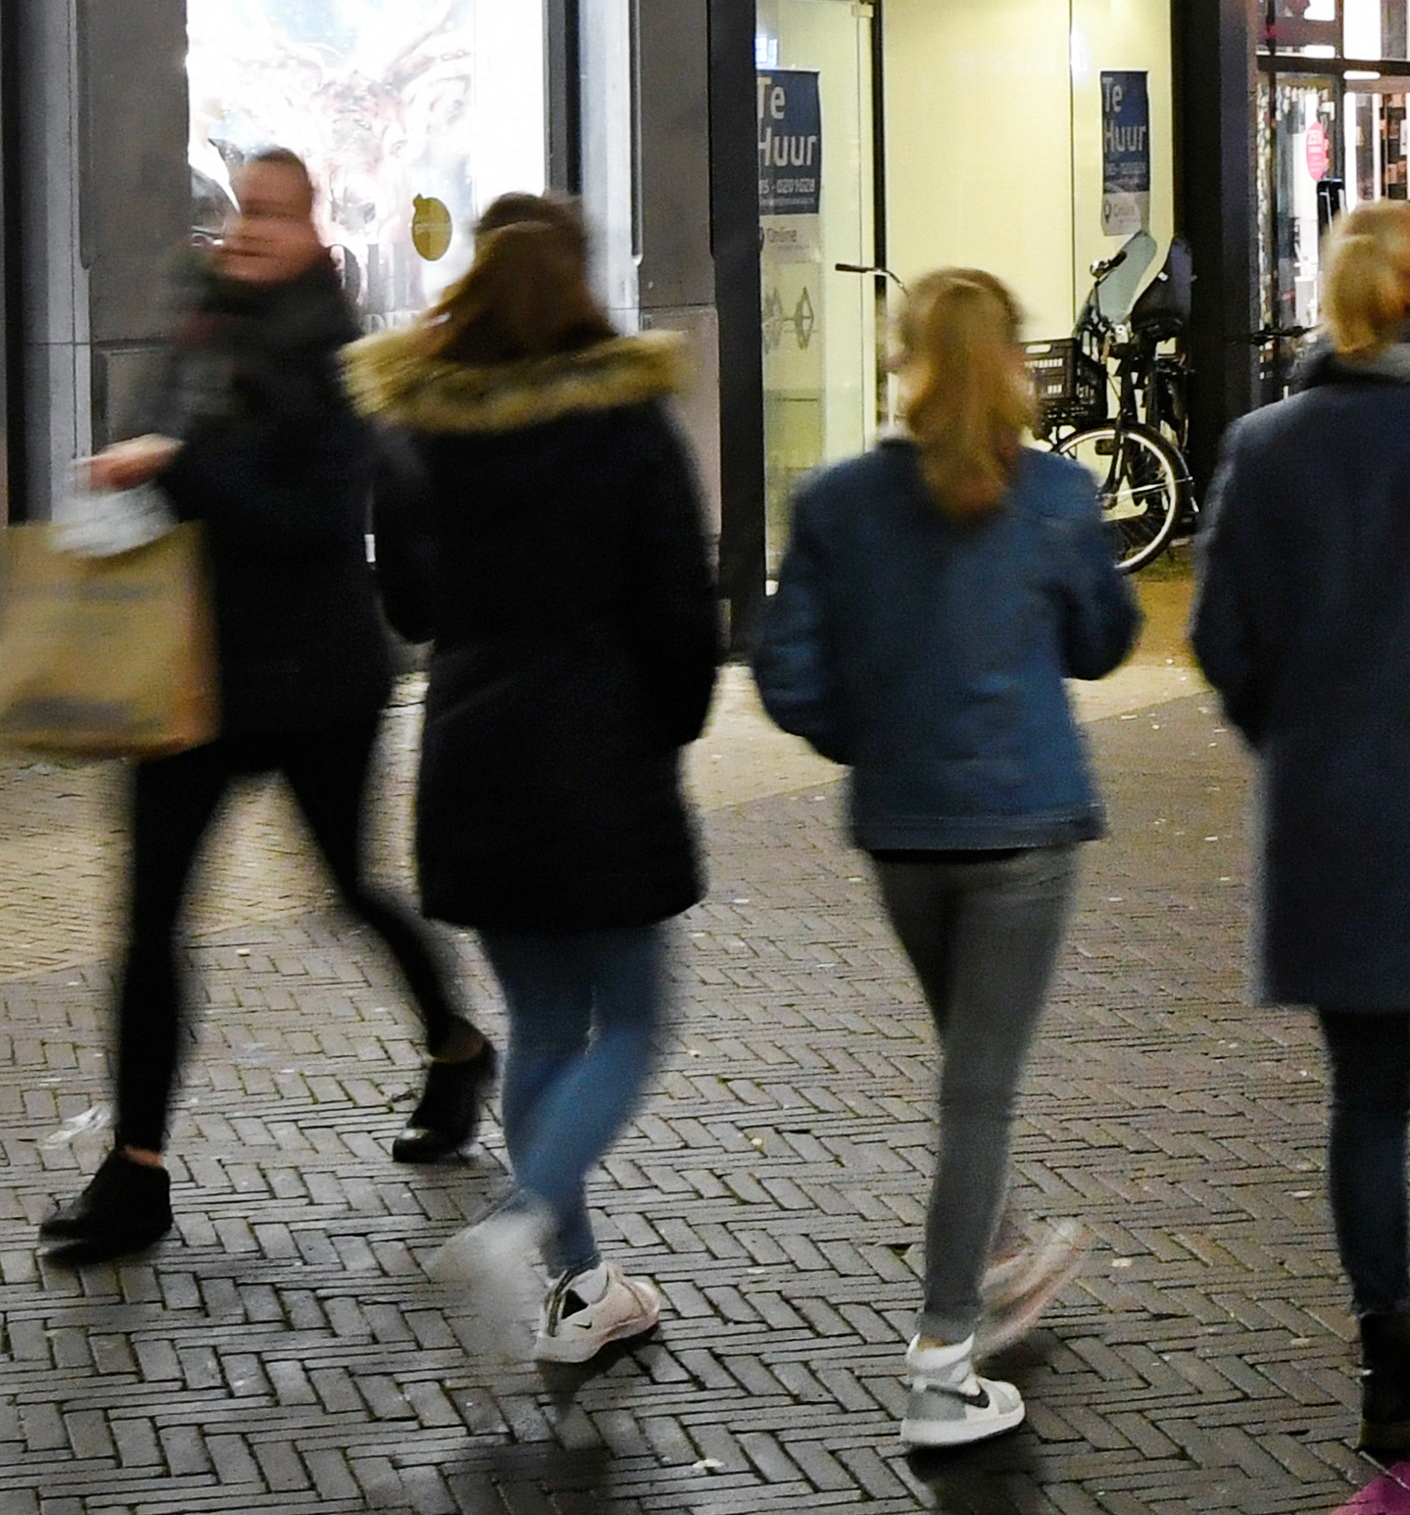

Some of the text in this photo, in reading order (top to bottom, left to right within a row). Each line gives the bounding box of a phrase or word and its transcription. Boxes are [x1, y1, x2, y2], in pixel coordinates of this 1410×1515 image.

[757, 76, 785, 119] Te
[1102, 77, 1123, 113] Te
[759, 127, 817, 167] Huur
[1104, 120, 1147, 153] Huur
